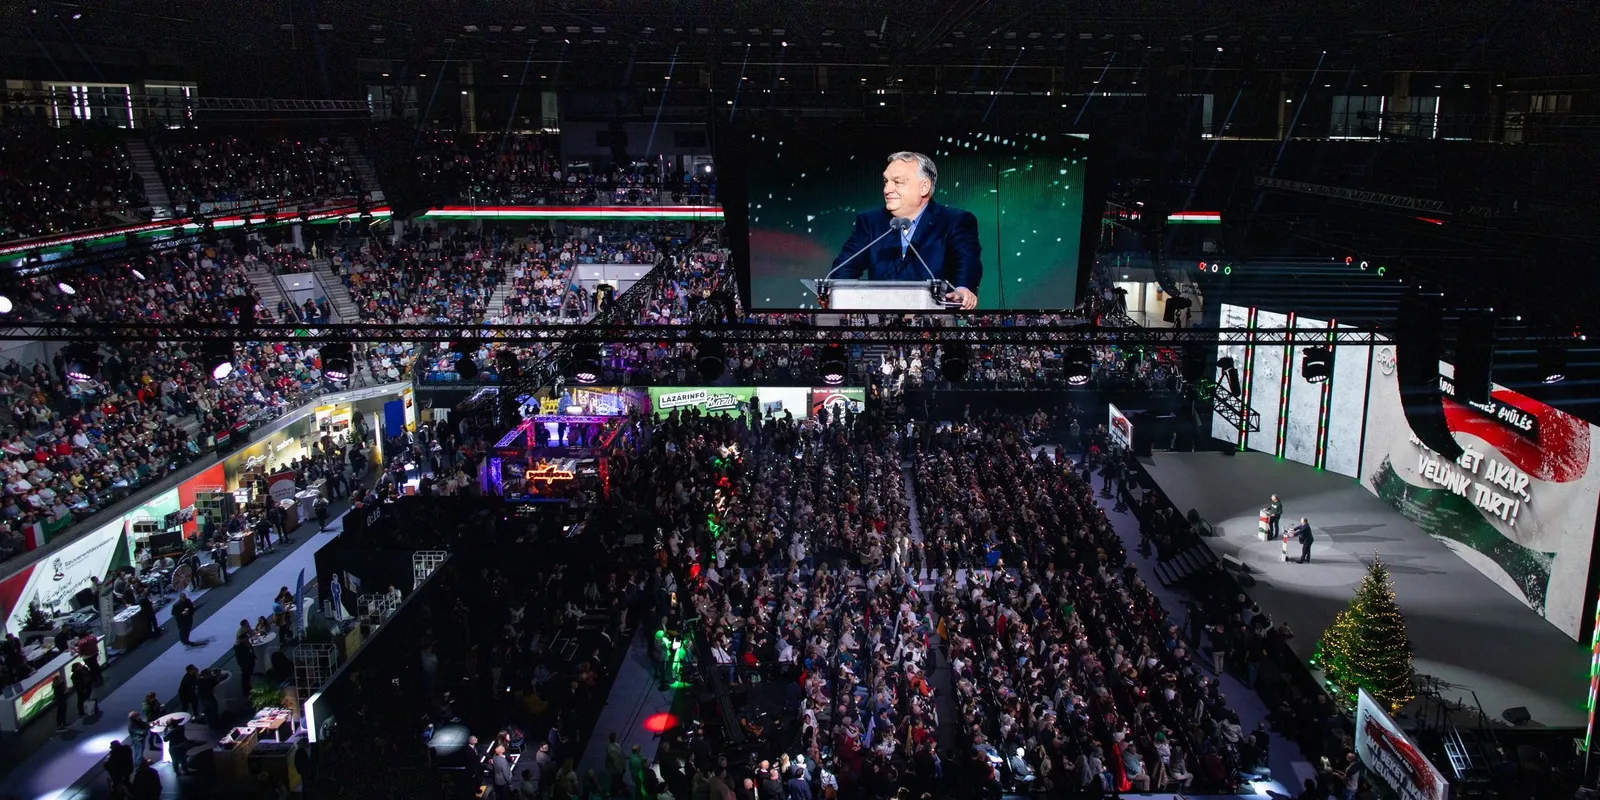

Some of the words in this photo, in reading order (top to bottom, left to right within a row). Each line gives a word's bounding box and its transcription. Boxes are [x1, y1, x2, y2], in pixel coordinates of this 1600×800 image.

[1418, 455, 1472, 497] VELÜNK
[1474, 482, 1520, 527] TART!
[1485, 459, 1531, 502] AKAR,
